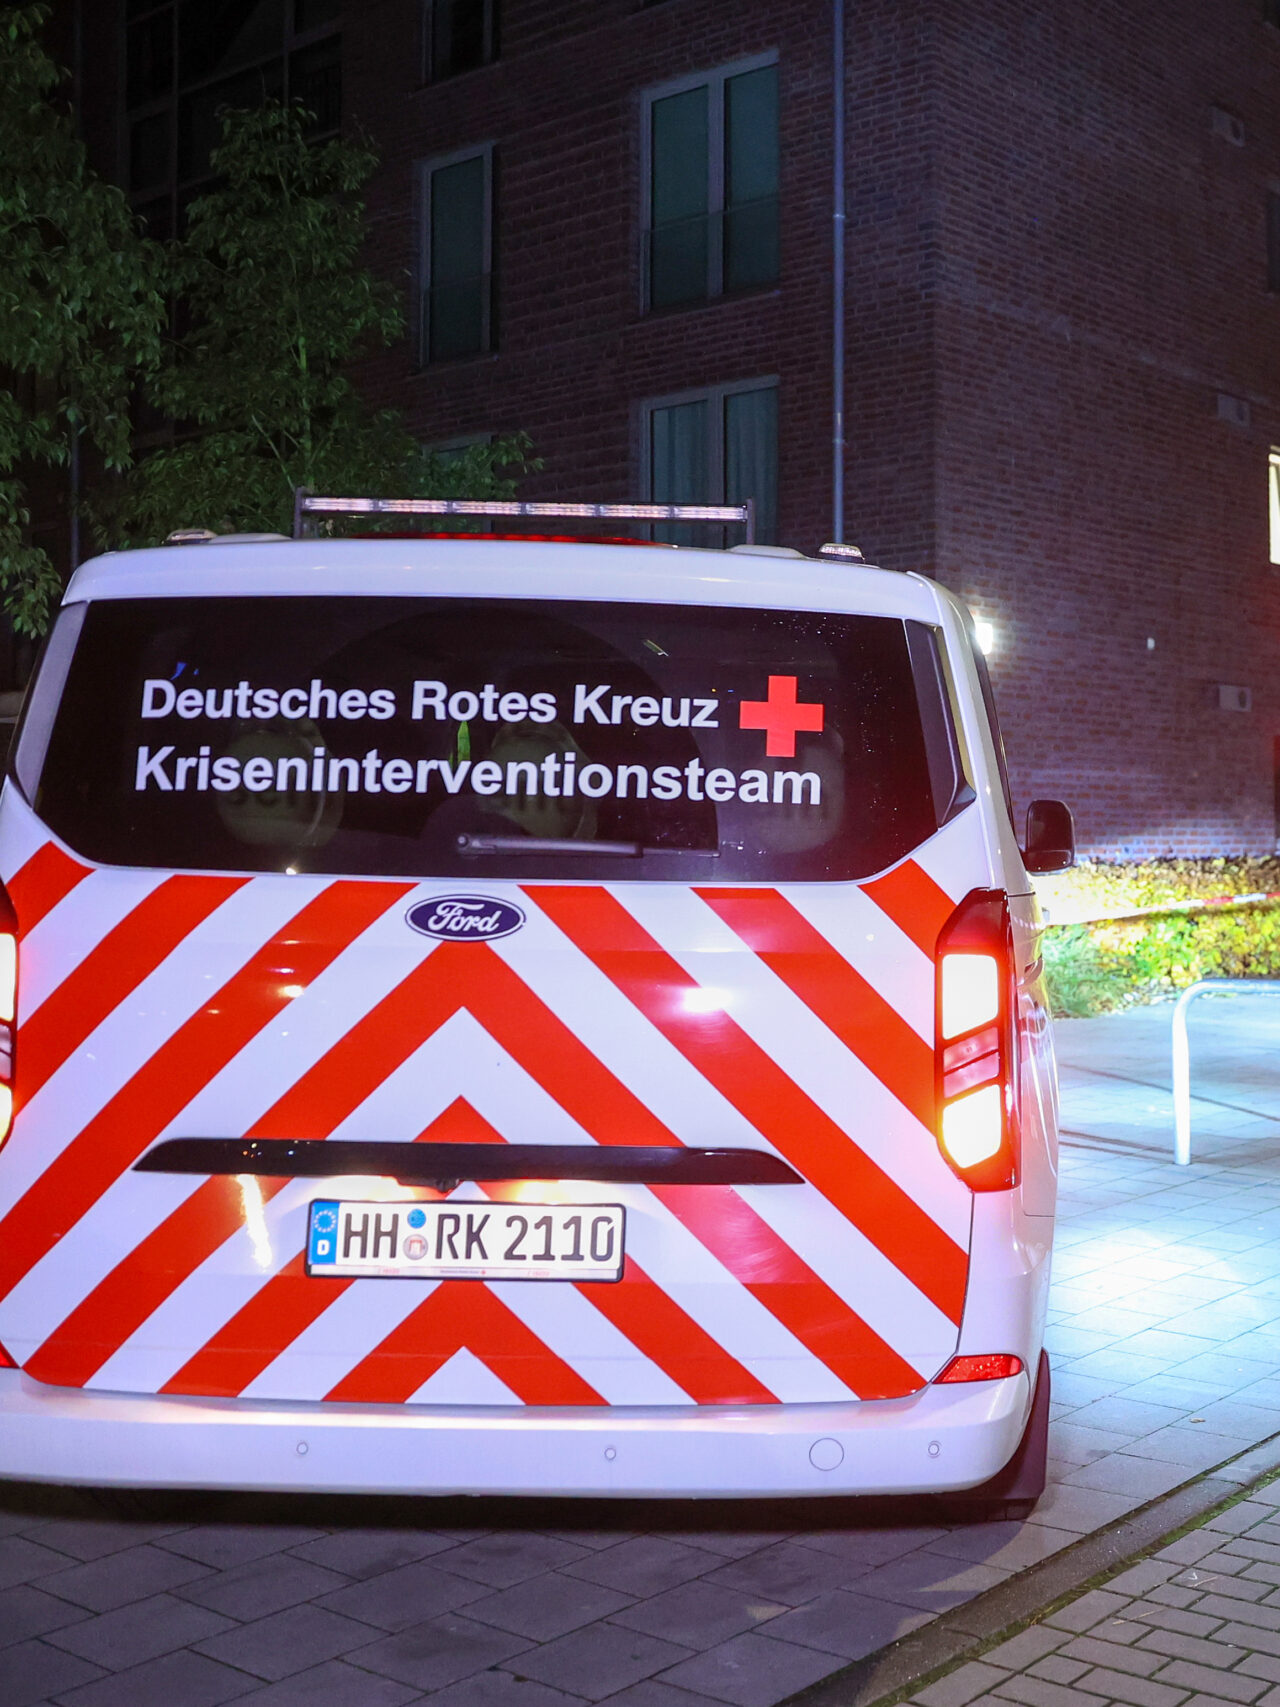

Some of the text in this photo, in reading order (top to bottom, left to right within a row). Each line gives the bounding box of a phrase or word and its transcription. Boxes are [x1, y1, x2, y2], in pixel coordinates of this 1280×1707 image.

[141, 679, 719, 729] Deutsches Rotes Kreuz
[135, 745, 822, 806] Kriseninterventionsteam
[428, 901, 502, 932] Ford
[317, 1239, 329, 1256] D
[343, 1213, 615, 1262] HH RK 2110
